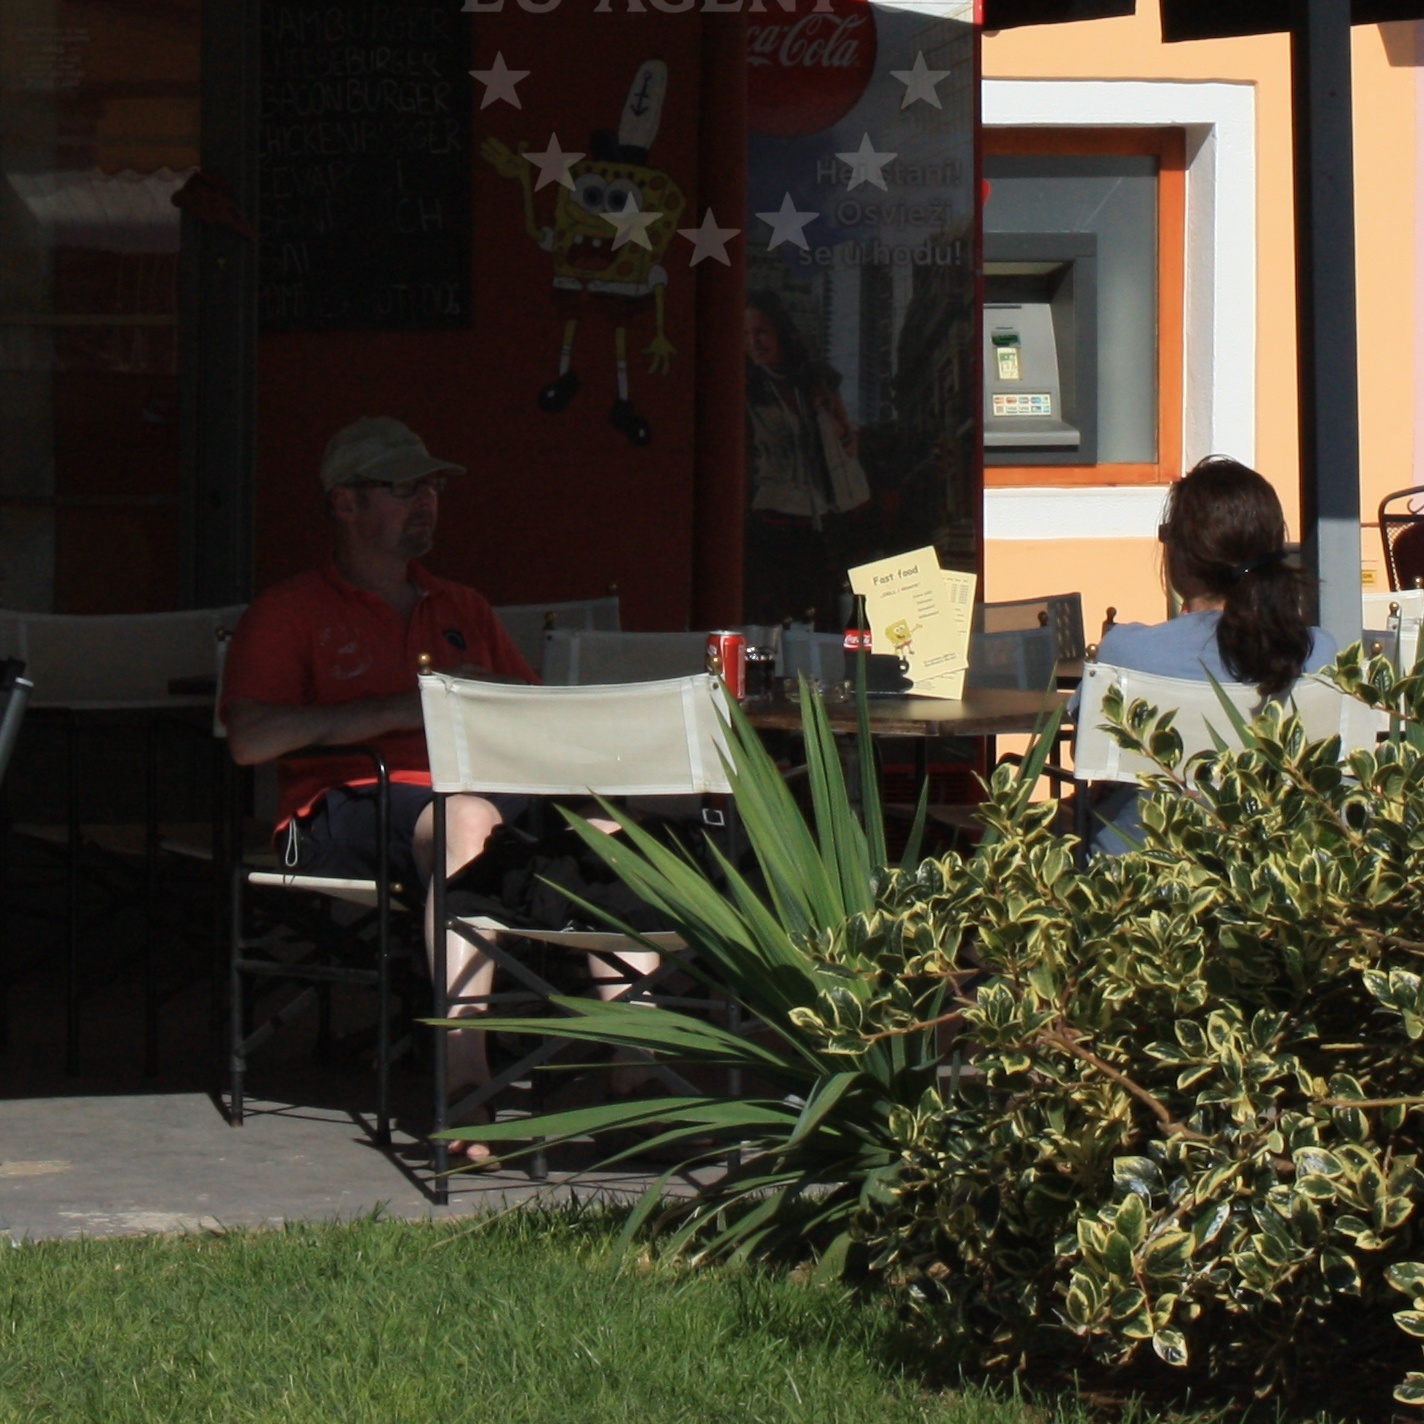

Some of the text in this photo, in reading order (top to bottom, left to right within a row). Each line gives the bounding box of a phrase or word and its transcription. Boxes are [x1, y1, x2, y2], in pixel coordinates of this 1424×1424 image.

[746, 13, 868, 68] ca-Cola
[872, 564, 919, 586] Fast food
